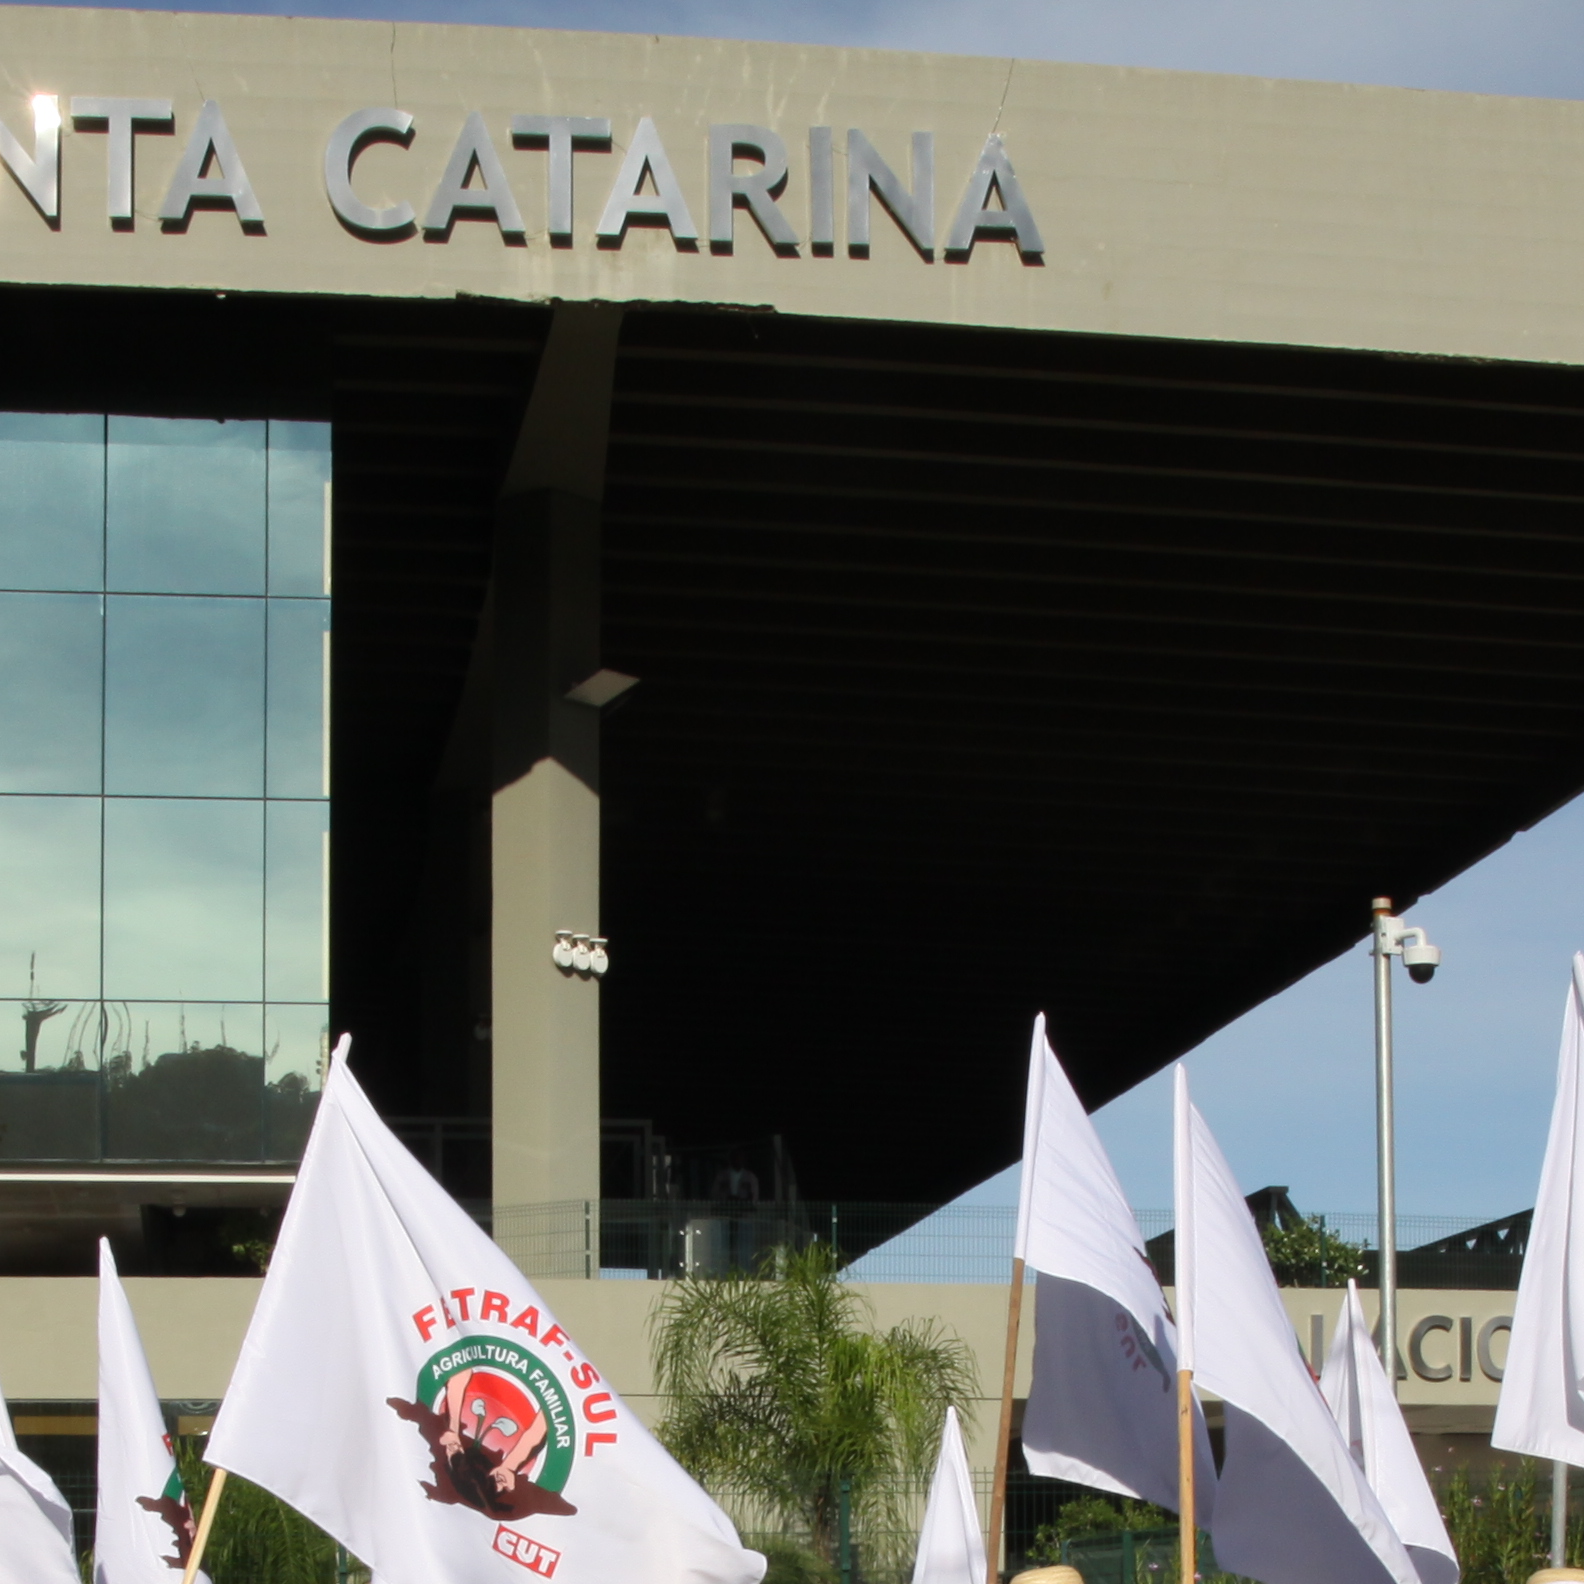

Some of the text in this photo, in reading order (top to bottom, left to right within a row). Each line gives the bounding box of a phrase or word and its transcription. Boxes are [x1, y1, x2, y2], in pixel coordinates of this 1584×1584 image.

[324, 107, 1044, 260] CATARINA
[528, 1368, 571, 1449] FAMILIAR
[495, 1529, 558, 1576] CUT
